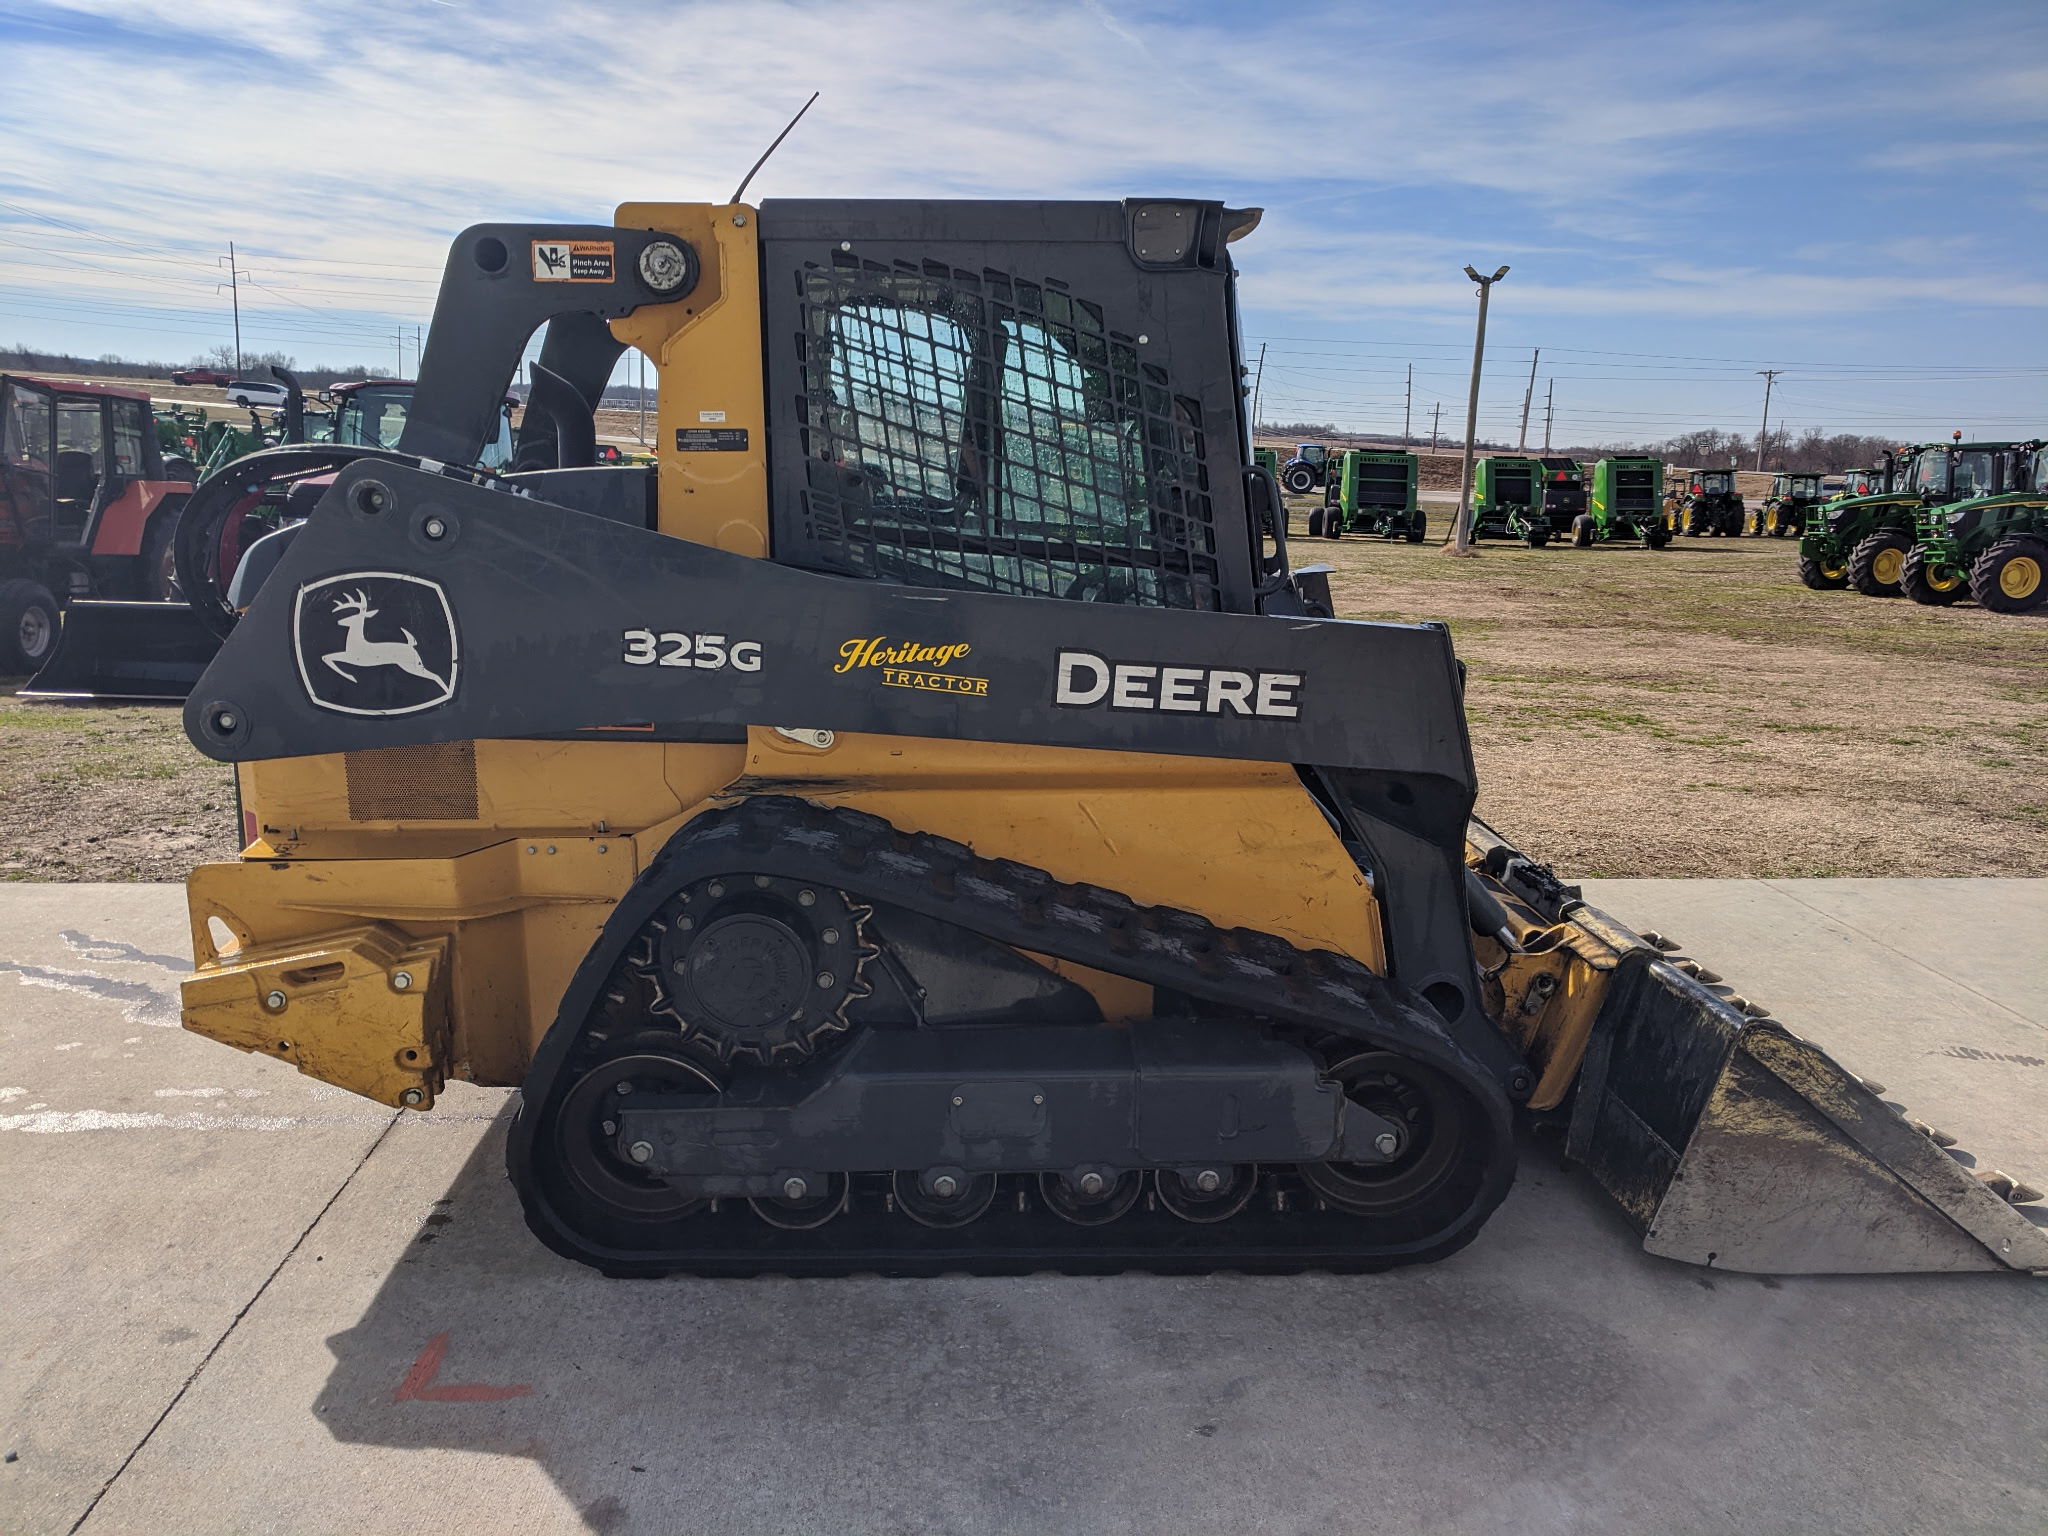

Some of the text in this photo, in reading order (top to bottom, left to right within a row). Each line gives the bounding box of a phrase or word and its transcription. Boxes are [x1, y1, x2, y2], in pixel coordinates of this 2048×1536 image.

[572, 259, 592, 267] Pinch
[624, 629, 761, 672] 325G
[833, 636, 972, 674] Heritage
[883, 670, 989, 695] TRACTOR
[1056, 652, 1300, 717] DEERE
